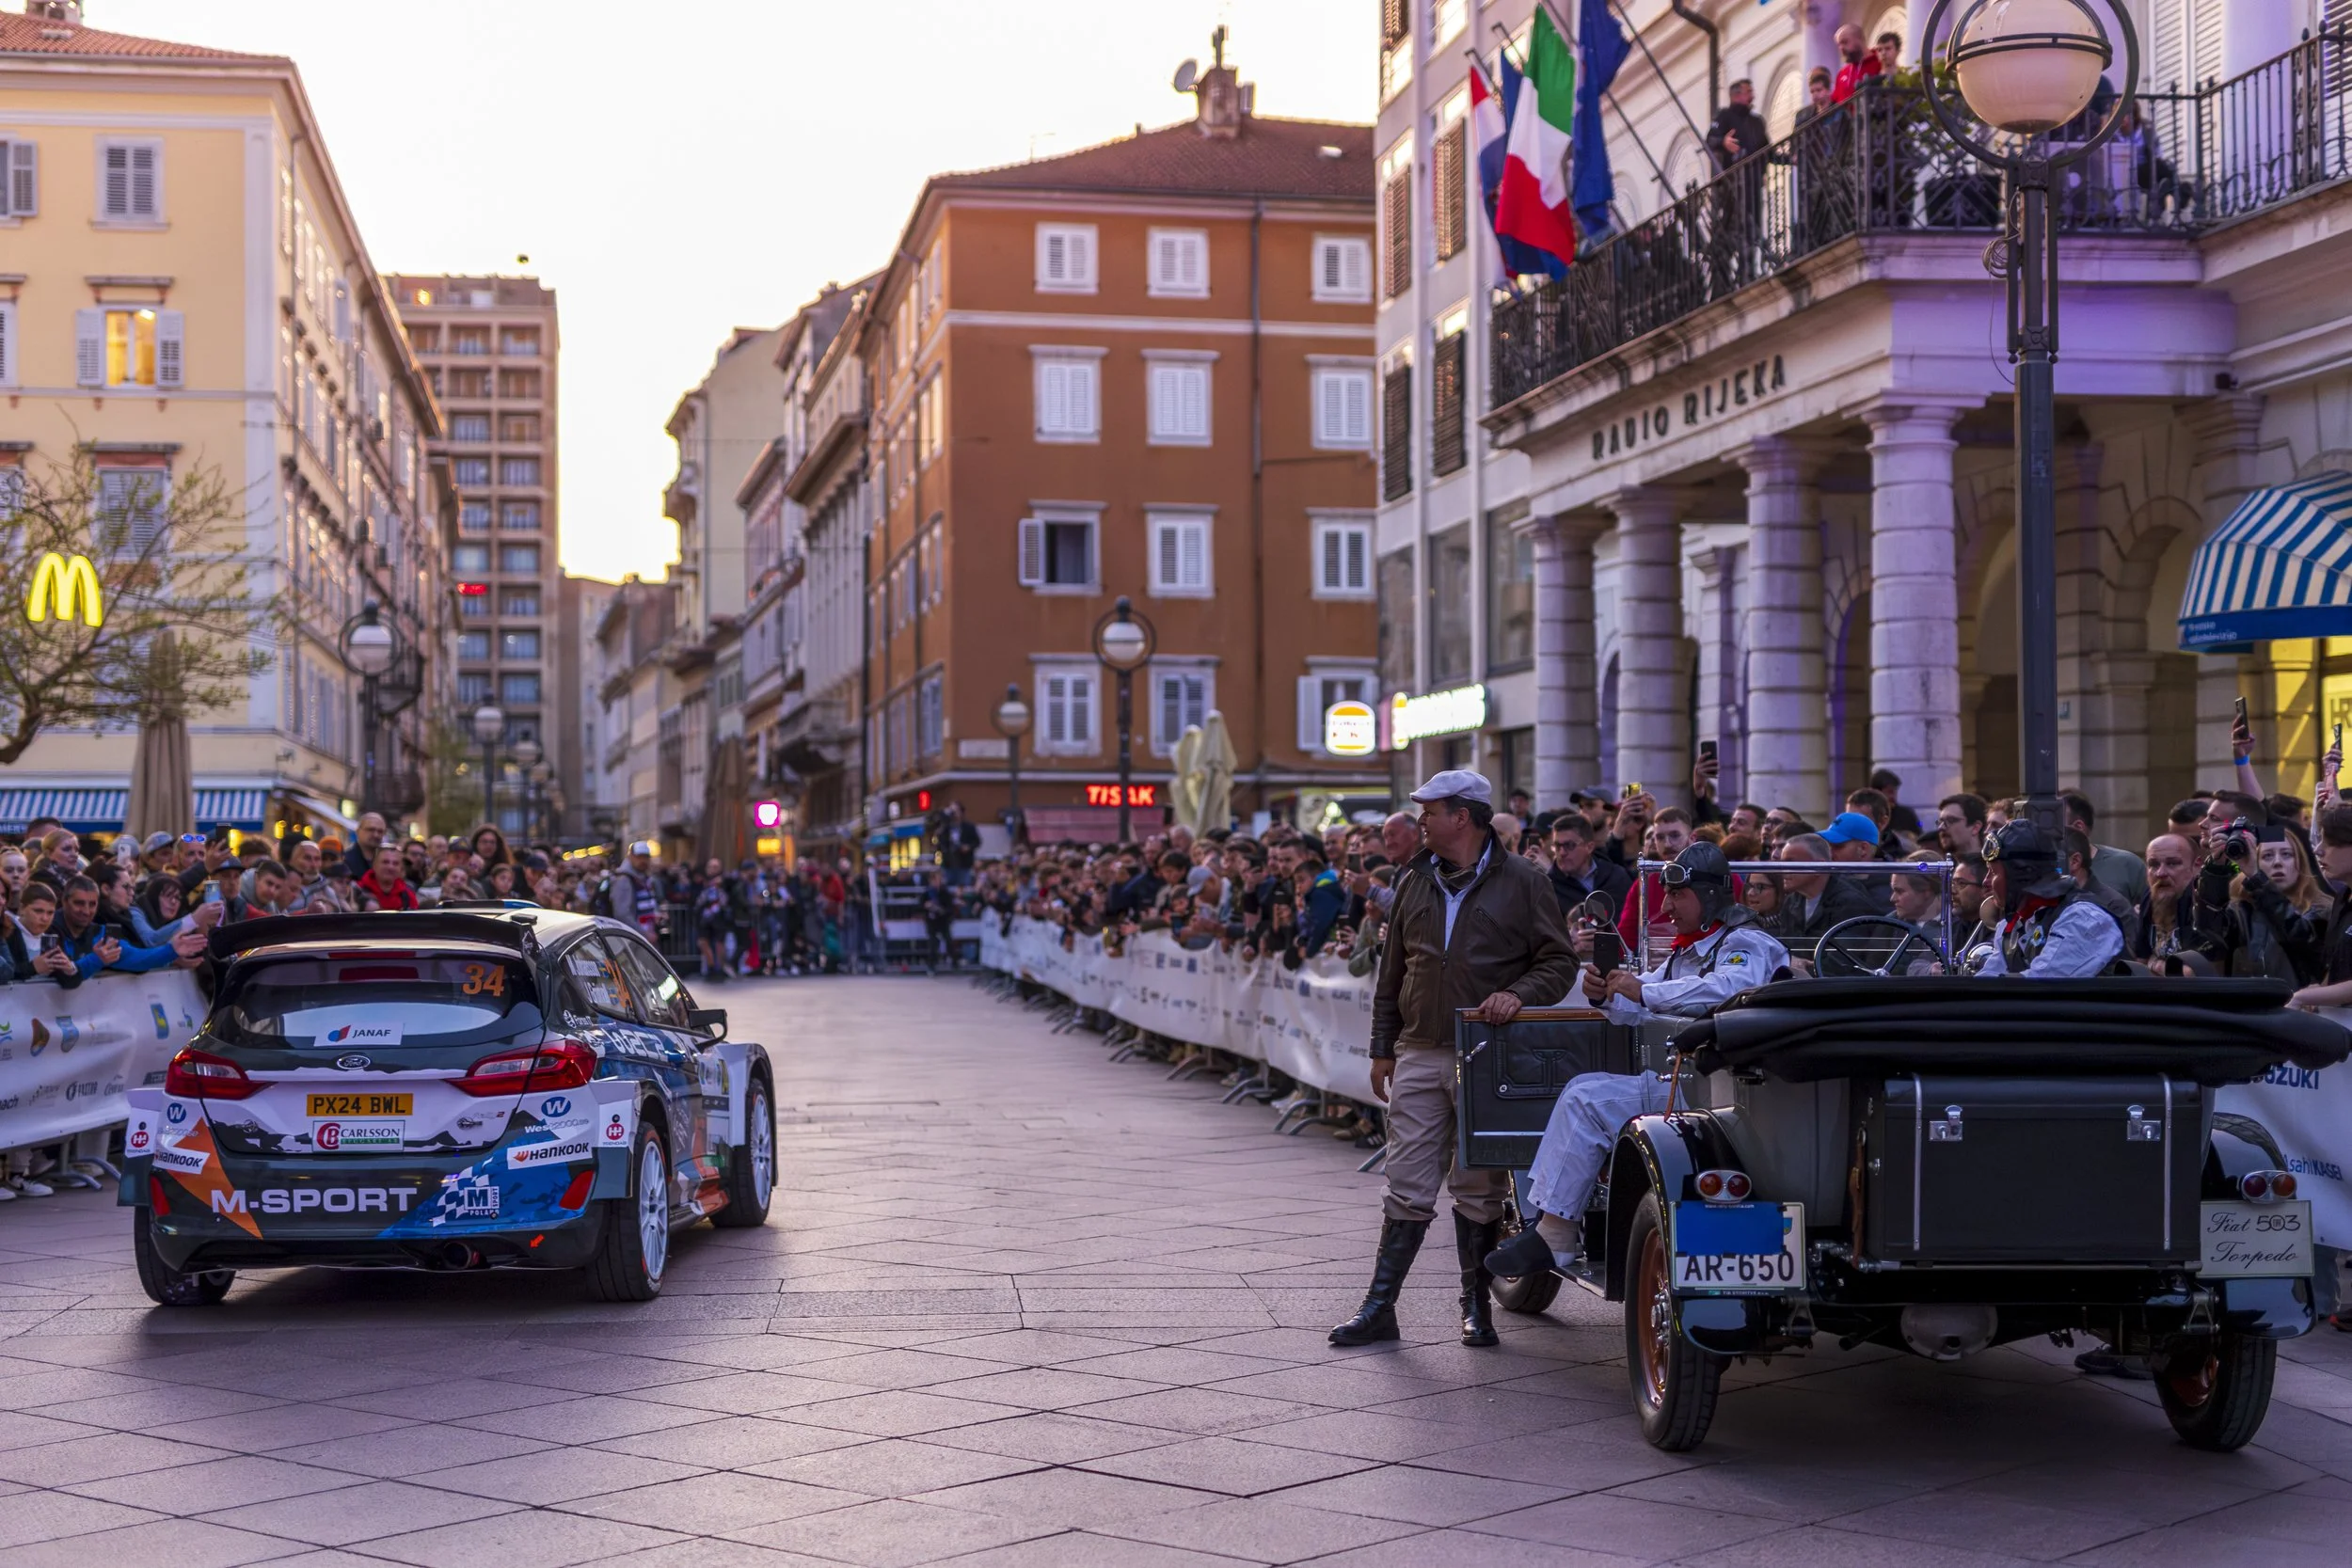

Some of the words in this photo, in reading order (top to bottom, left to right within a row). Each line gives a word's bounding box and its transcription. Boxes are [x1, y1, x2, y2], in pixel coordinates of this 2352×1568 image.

[1592, 404, 1669, 461] RADIO
[1683, 354, 1786, 425] RIJEKA
[462, 964, 505, 996] 34
[352, 1029, 391, 1038] JANAF
[2265, 1065, 2319, 1089] UZUKI
[313, 1097, 362, 1114] PX24
[370, 1096, 405, 1114] BWL
[341, 1129, 400, 1137] CARLSSON
[211, 1187, 417, 1213] M-SPORT
[468, 1189, 488, 1207] M
[2207, 1212, 2250, 1233] Fiat
[2255, 1214, 2301, 1231] 503
[1683, 1251, 1795, 1282] AR-650
[2211, 1241, 2298, 1269] Torpedo
